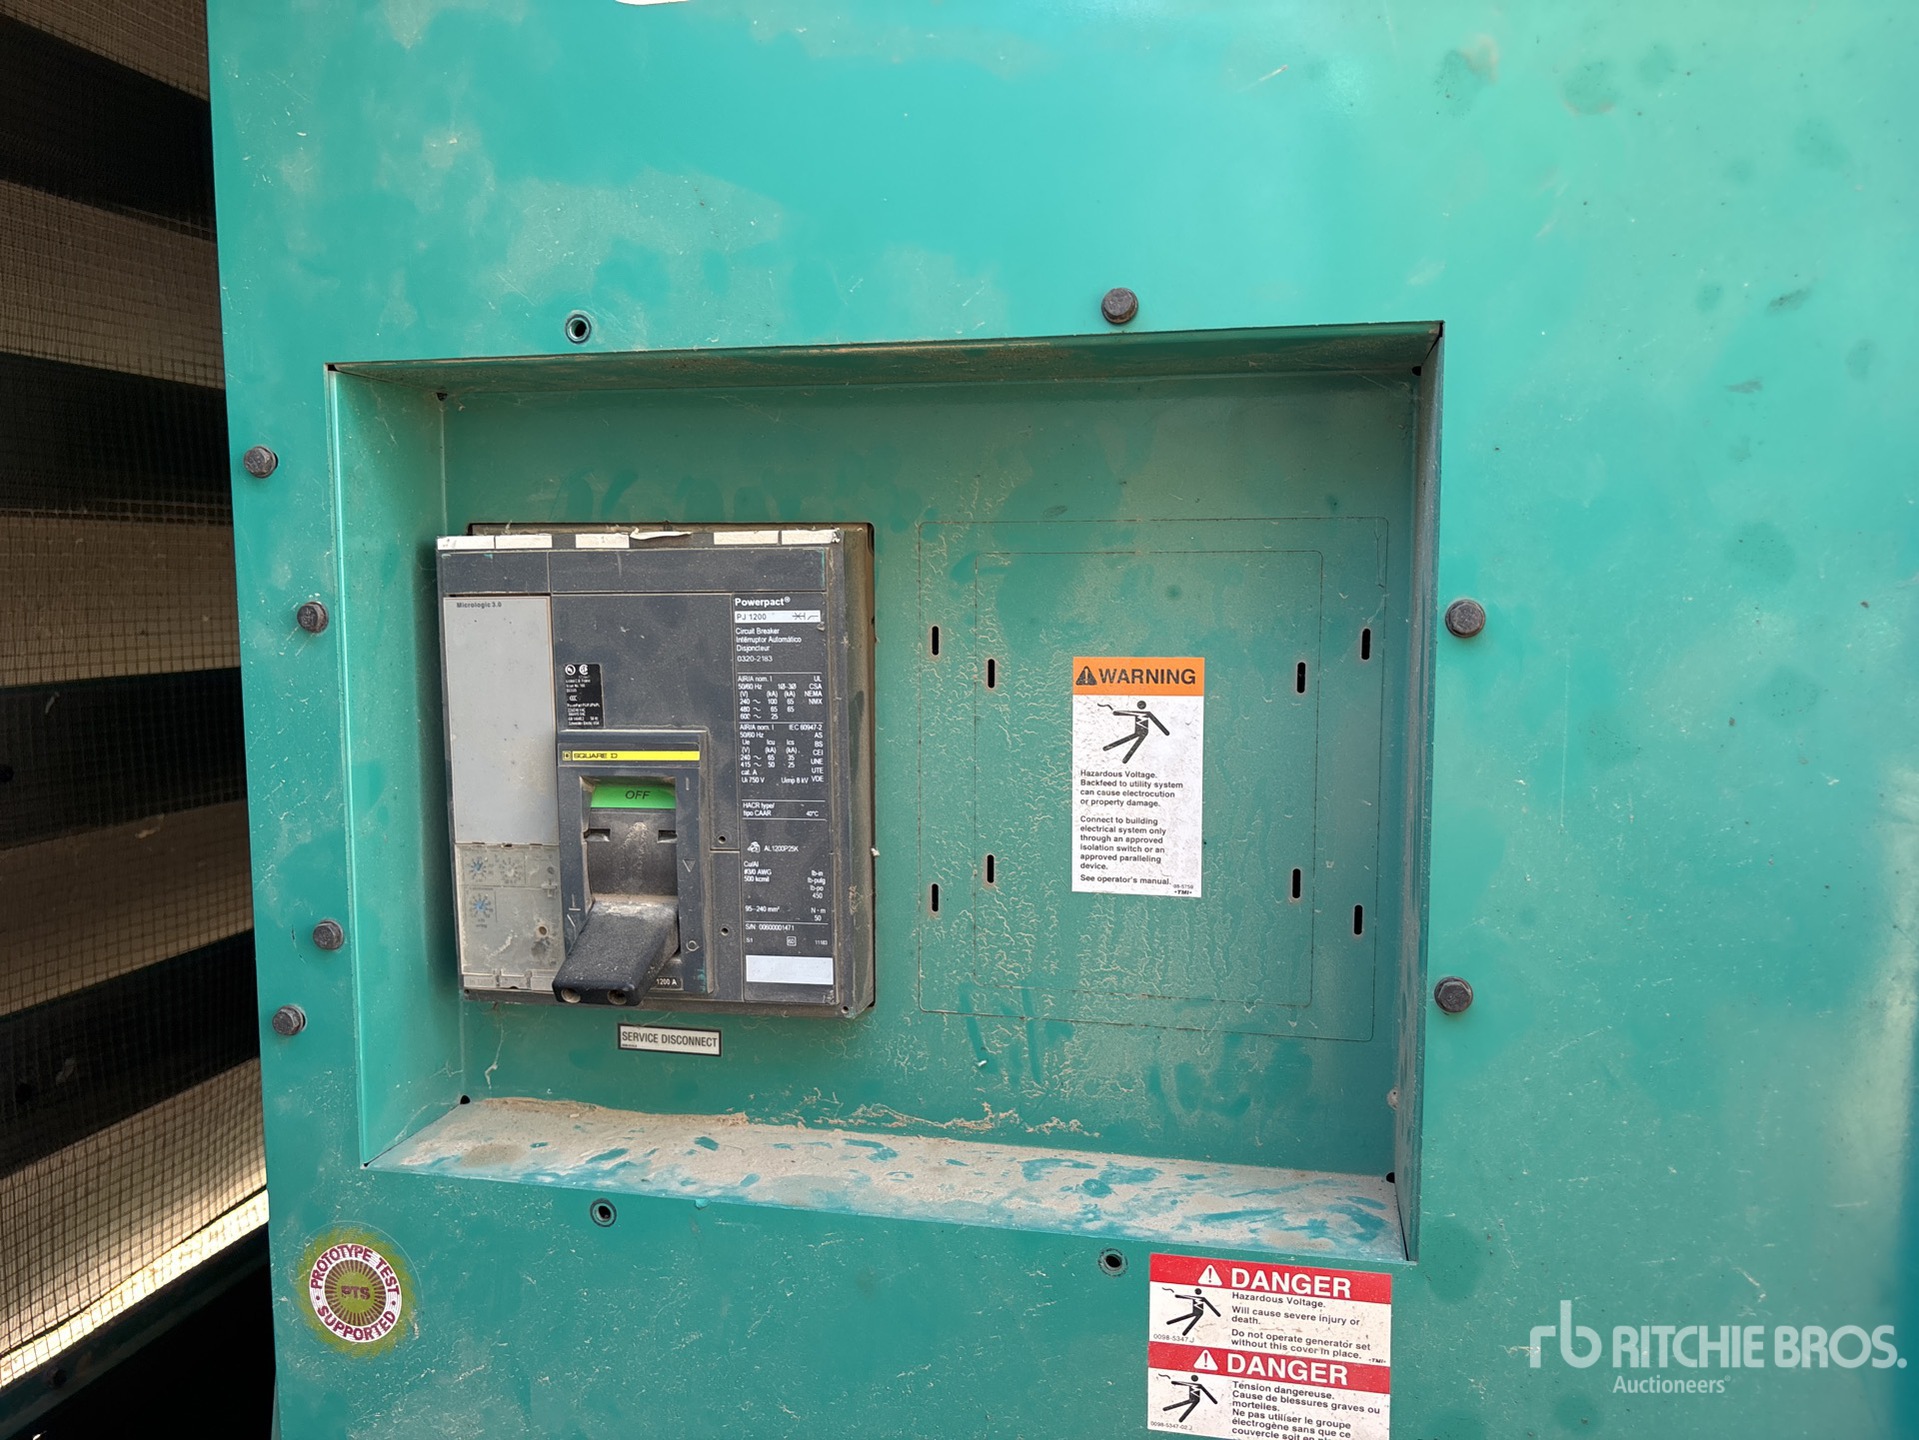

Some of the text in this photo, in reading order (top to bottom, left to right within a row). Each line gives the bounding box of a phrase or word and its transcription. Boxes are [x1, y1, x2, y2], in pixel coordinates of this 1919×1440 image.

[1099, 668, 1196, 684] WARNING
[1125, 771, 1157, 779] Voltage.
[1130, 781, 1151, 789] utility
[625, 790, 650, 800] OFF
[1126, 800, 1161, 808] damage.
[1126, 817, 1158, 826] building
[1080, 835, 1111, 843] through
[1118, 827, 1147, 835] system
[1080, 854, 1161, 864] approved paralleling
[1097, 875, 1138, 884] operator's
[622, 1031, 717, 1047] SERVICE DISCONNECT
[310, 1245, 373, 1289] PROTOTYPE
[375, 1258, 400, 1295] TEST
[1231, 1268, 1351, 1298] DANGER
[341, 1286, 370, 1300] PTS
[1232, 1292, 1326, 1308] Hazardous Voltage.
[318, 1305, 396, 1340] SUPPORTED
[1232, 1305, 1250, 1314] Will
[1252, 1309, 1281, 1318] cause
[1284, 1313, 1316, 1321] severe
[1319, 1314, 1346, 1326] injury
[1232, 1316, 1261, 1325] death.
[1231, 1329, 1244, 1337] Do
[1248, 1331, 1263, 1339] not
[1266, 1334, 1303, 1343] operate
[1306, 1337, 1353, 1348] generator
[1231, 1339, 1267, 1348] without
[1270, 1342, 1288, 1351] this
[1320, 1347, 1330, 1355] in
[1332, 1349, 1362, 1359] place.
[1227, 1353, 1348, 1385] DANGER
[1232, 1381, 1334, 1400] Tension dangereuse.
[1232, 1390, 1263, 1400] Cause
[1280, 1396, 1328, 1408] blessures
[1331, 1402, 1365, 1413] graves
[1232, 1401, 1280, 1411] mortelles.
[1232, 1417, 1289, 1431] électrogène
[1292, 1426, 1315, 1434] sans
[1318, 1430, 1338, 1438] que
[1268, 1413, 1302, 1424] utiliser
[1316, 1419, 1351, 1430] groupe
[1232, 1427, 1279, 1439] couvercle
